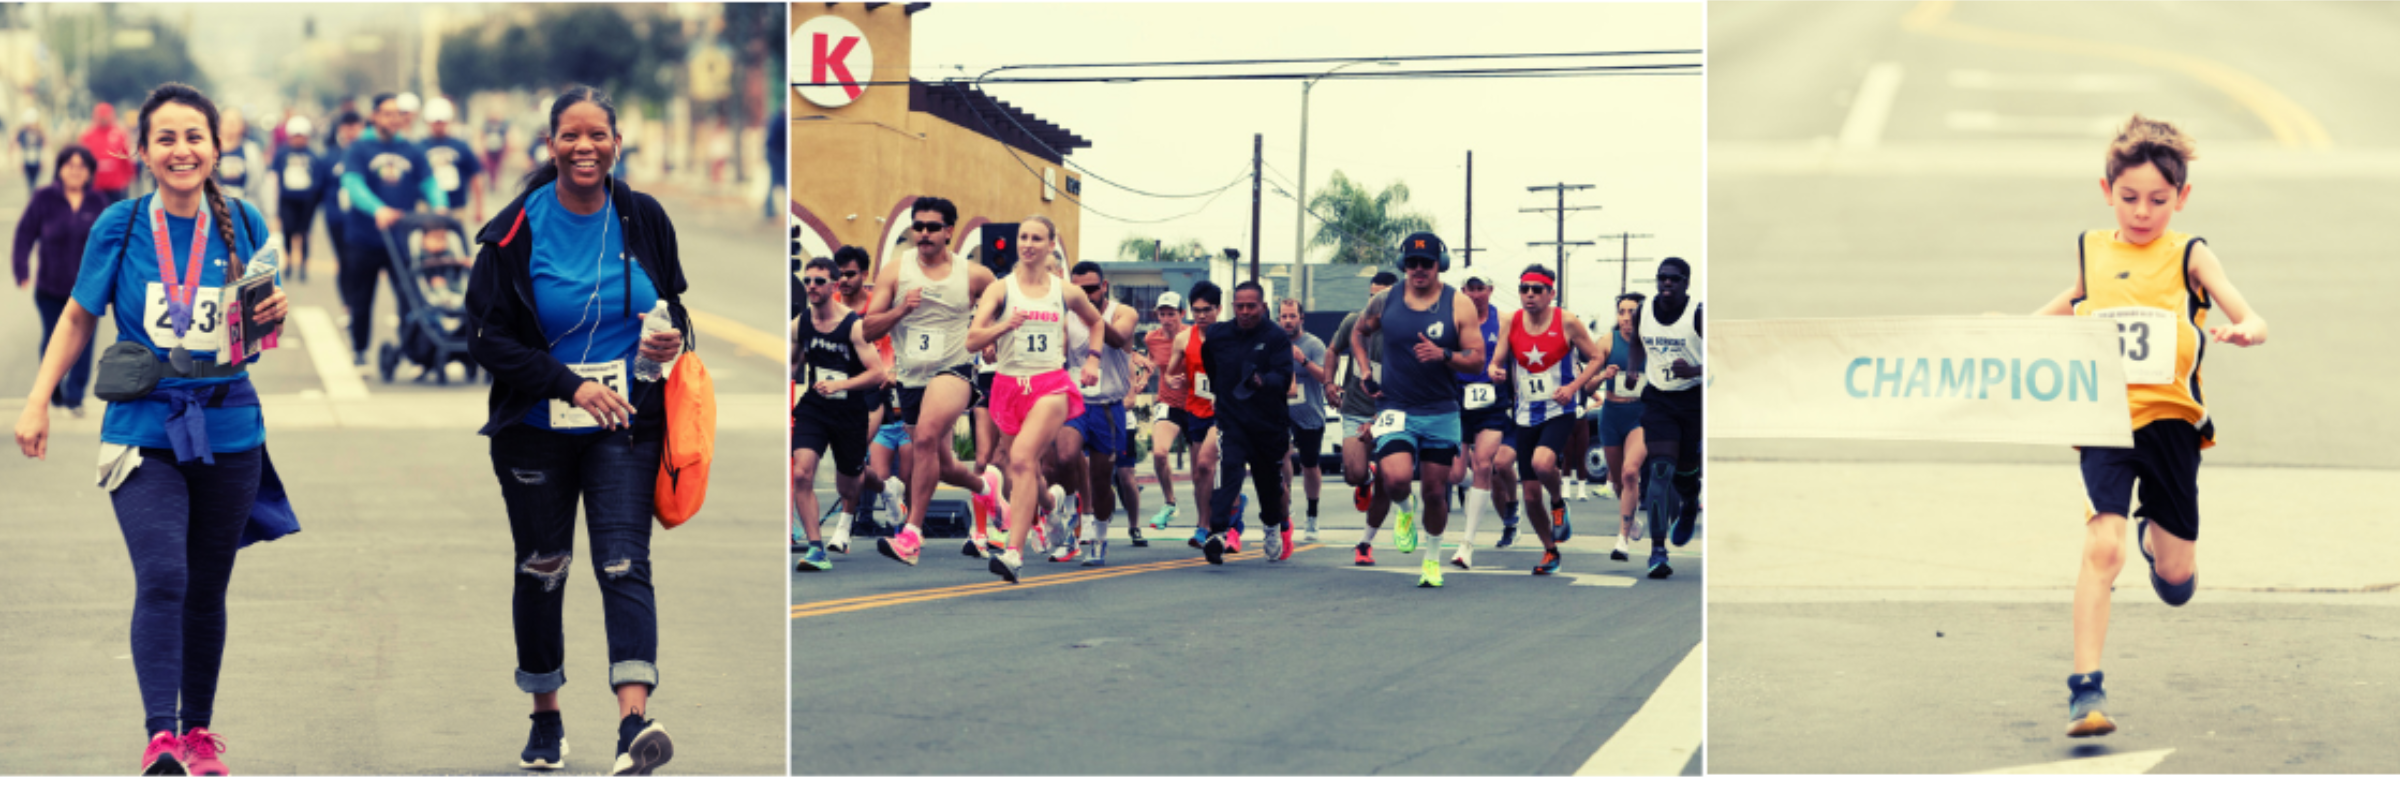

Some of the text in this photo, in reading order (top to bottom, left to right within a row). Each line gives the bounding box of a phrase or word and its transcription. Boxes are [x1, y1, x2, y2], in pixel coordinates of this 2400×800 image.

[811, 32, 863, 101] K
[919, 334, 930, 351] 3
[1027, 334, 1048, 352] 13
[1529, 379, 1545, 394] 14
[1843, 356, 2099, 402] CHAMPION
[1471, 388, 1488, 402] 12
